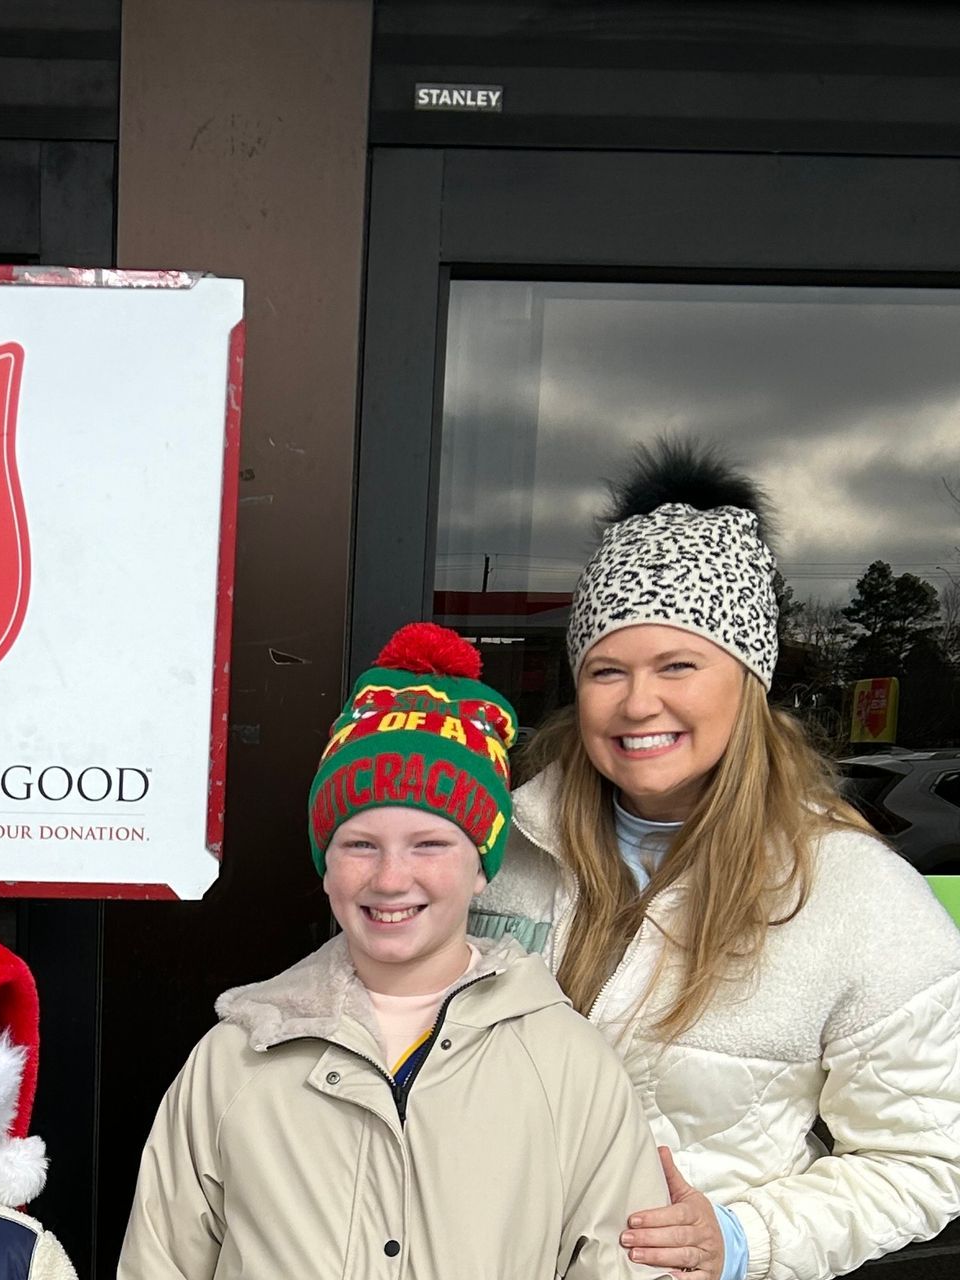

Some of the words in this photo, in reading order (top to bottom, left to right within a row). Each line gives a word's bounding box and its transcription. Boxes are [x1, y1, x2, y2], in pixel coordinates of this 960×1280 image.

[418, 88, 501, 107] STANLEY
[377, 711, 427, 731] OF
[440, 715, 467, 745] A
[0, 764, 150, 803] GOOD
[39, 824, 151, 842] DONATION.
